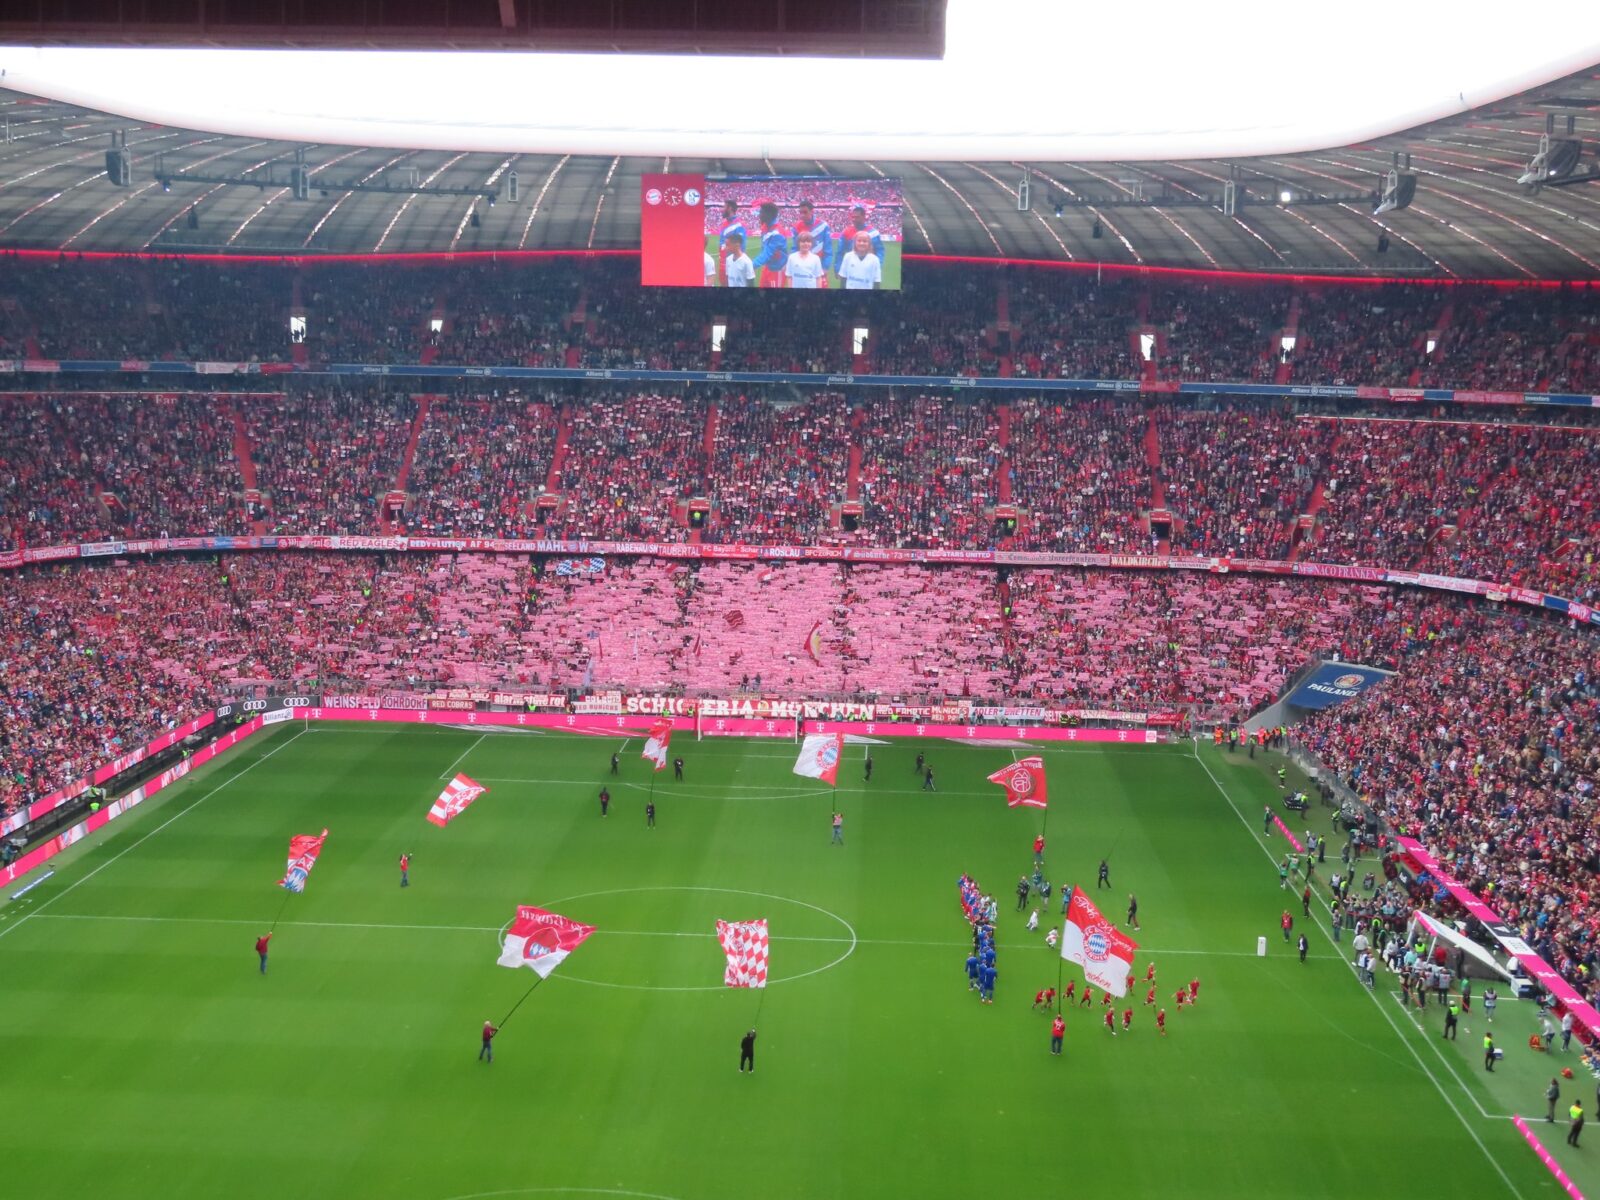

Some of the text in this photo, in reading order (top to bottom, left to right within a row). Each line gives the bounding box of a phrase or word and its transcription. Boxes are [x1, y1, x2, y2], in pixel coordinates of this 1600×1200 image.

[340, 539, 399, 547] RED EAGLES
[658, 545, 700, 556] TAUBERTAL
[1339, 565, 1378, 579] FRANKEN
[432, 700, 473, 709] RED COBRAS
[974, 707, 999, 716] ADLER
[264, 713, 284, 722] Allianz
